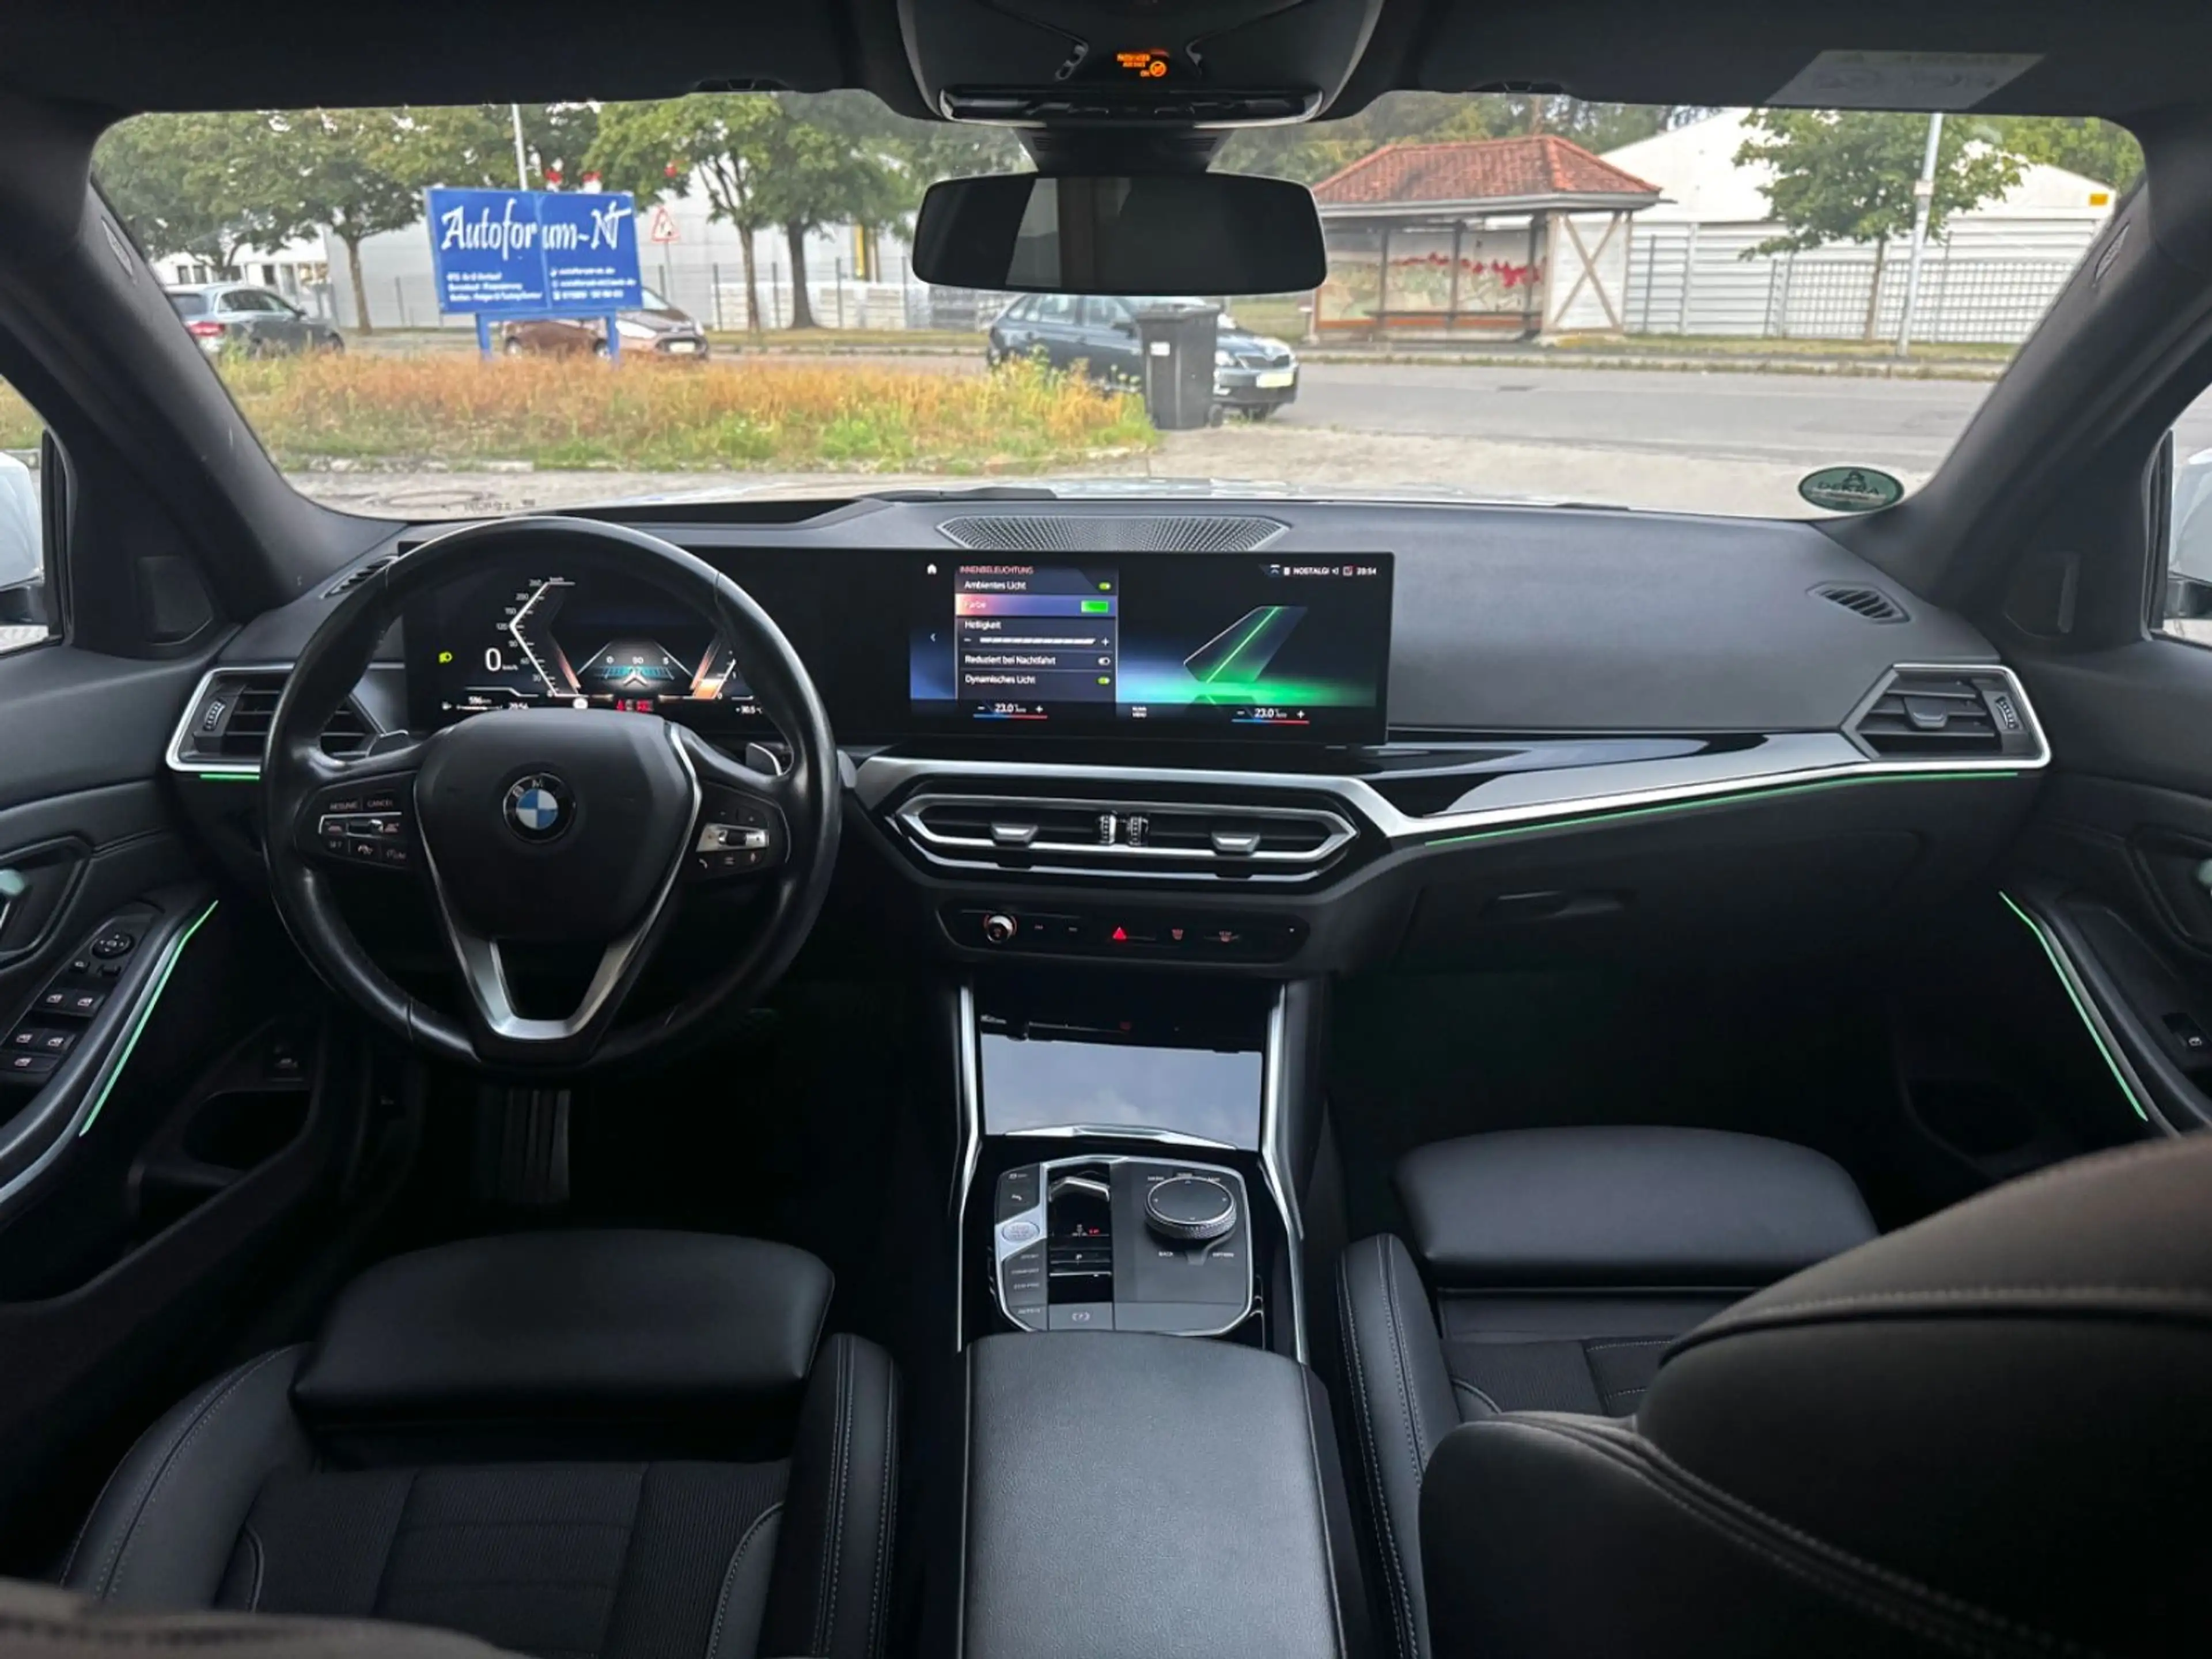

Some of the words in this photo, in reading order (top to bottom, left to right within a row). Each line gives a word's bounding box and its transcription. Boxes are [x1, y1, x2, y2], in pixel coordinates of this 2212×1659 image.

[959, 565, 1035, 575] INNENBELEUCHTUNG
[964, 581, 1006, 590] Ambientes
[1006, 581, 1027, 590] Licht
[964, 620, 1002, 631] Helligkeit
[486, 647, 501, 672] 0
[964, 654, 1002, 664] Reduziert
[1002, 655, 1015, 664] bei
[1016, 656, 1056, 665] Nachtfahrt
[964, 674, 1016, 684] Dynamisches
[1016, 675, 1036, 684] Licht
[1254, 707, 1275, 719] 23.0
